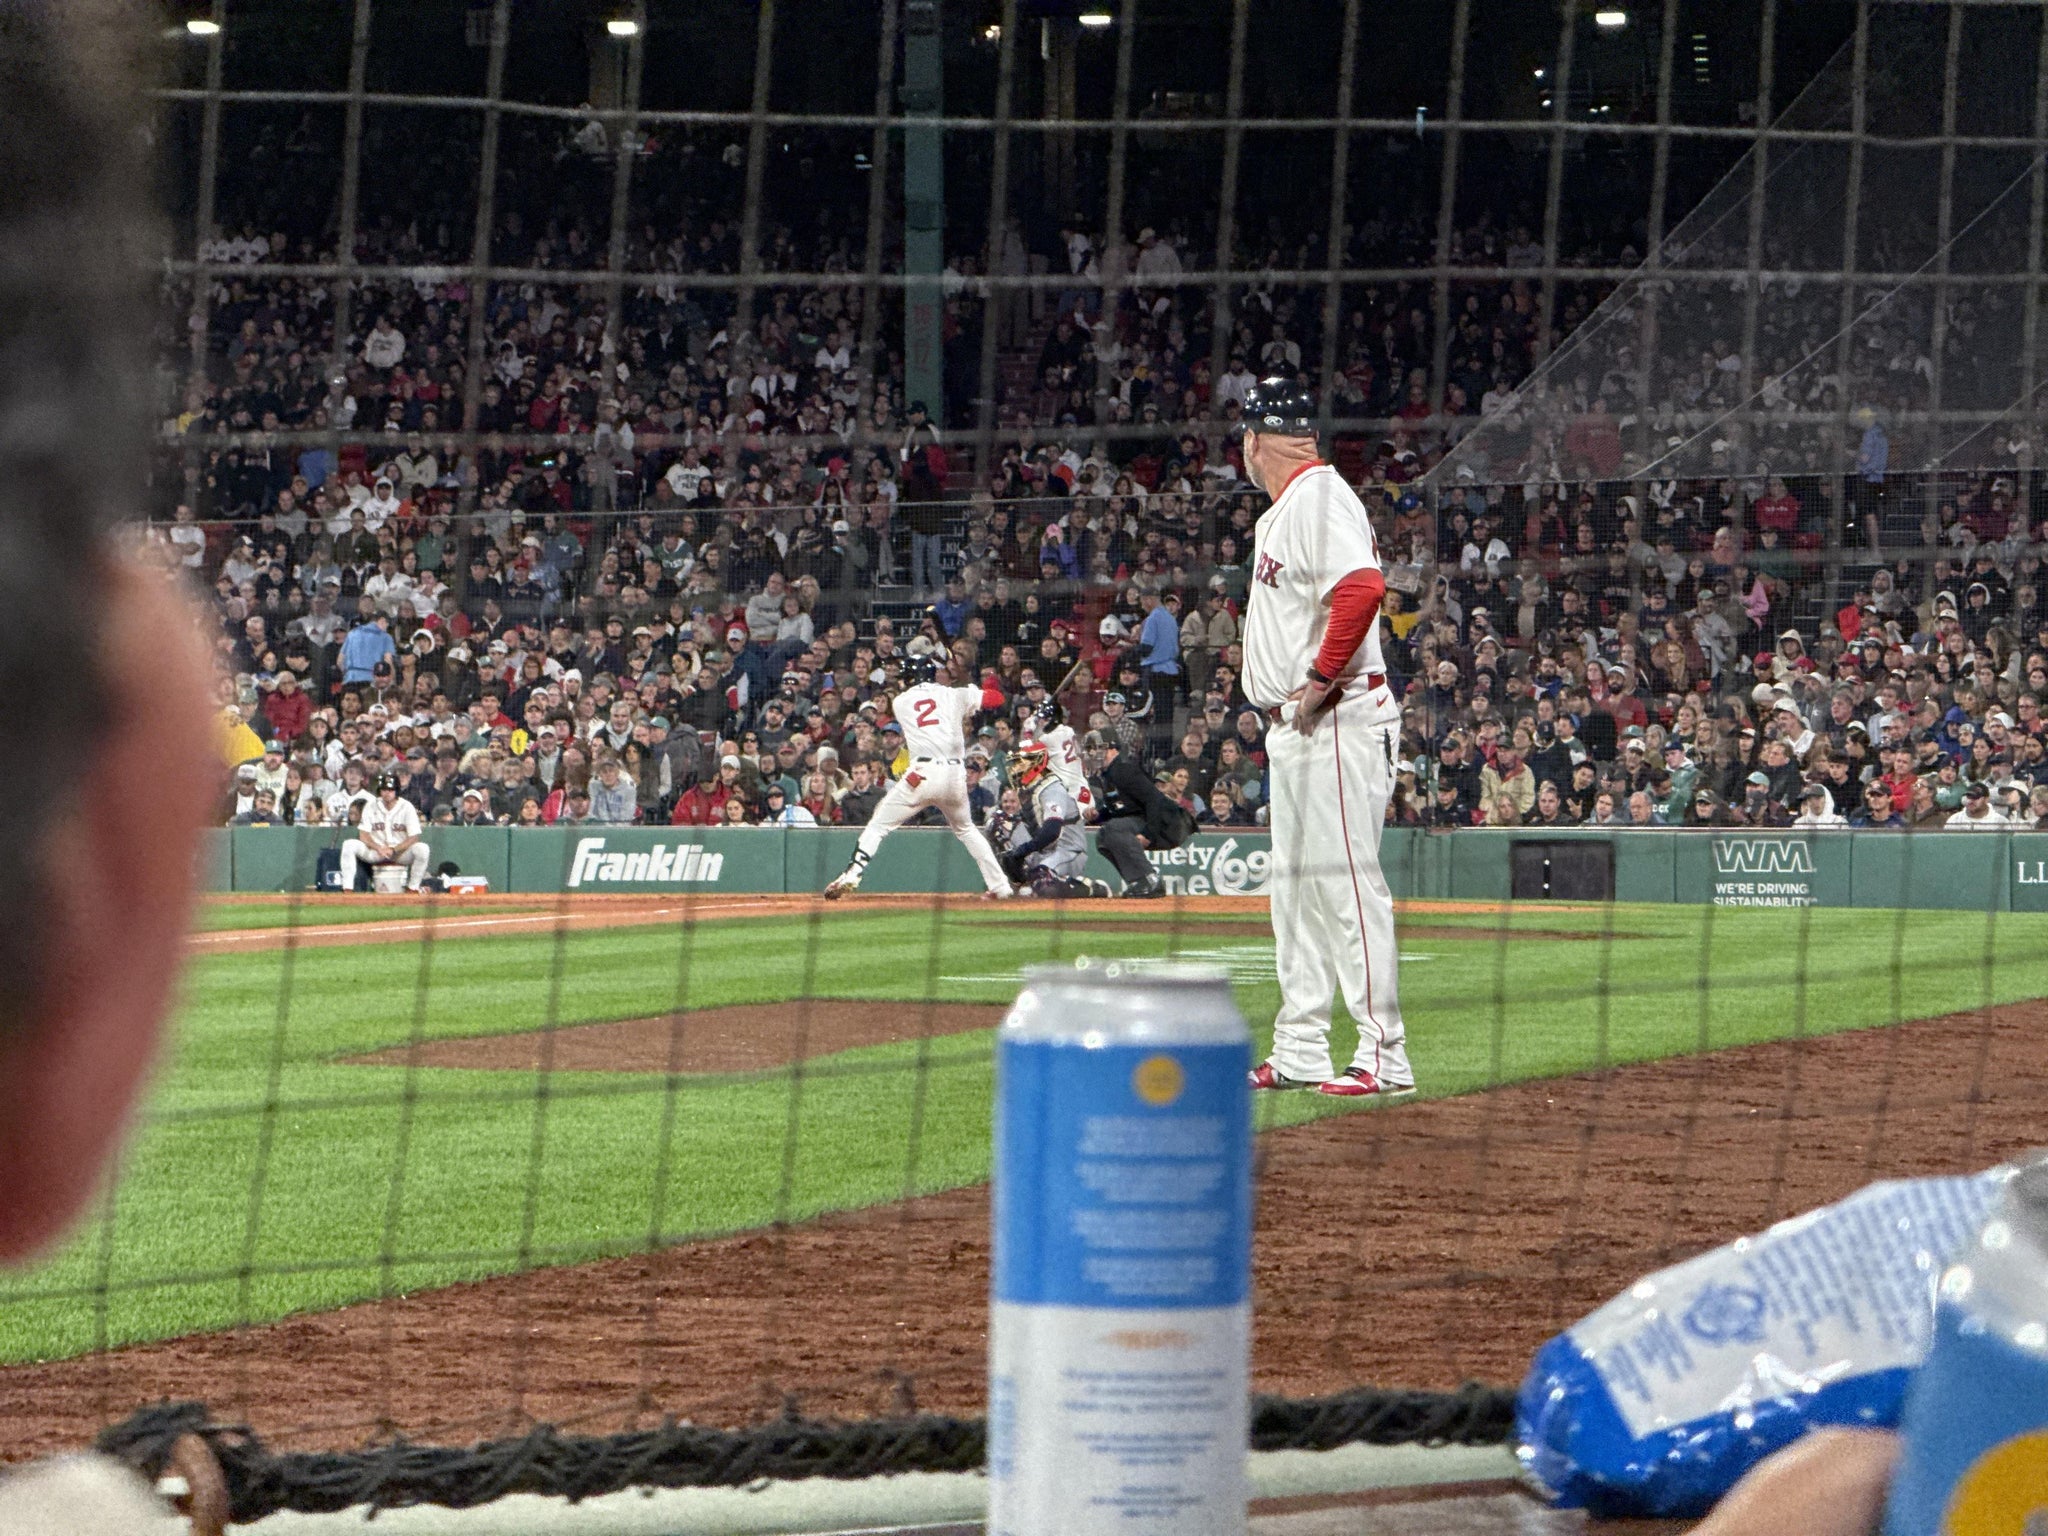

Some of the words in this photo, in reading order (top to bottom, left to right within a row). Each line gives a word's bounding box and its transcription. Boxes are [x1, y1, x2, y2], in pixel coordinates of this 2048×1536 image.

[1256, 552, 1284, 589] OX
[914, 699, 940, 728] 2
[567, 837, 724, 887] Franklin
[1712, 840, 1812, 872] WM
[1713, 896, 1810, 907] SUSTAINABILITY
[1716, 883, 1754, 894] WE'RE
[1757, 883, 1809, 894] DRIVING
